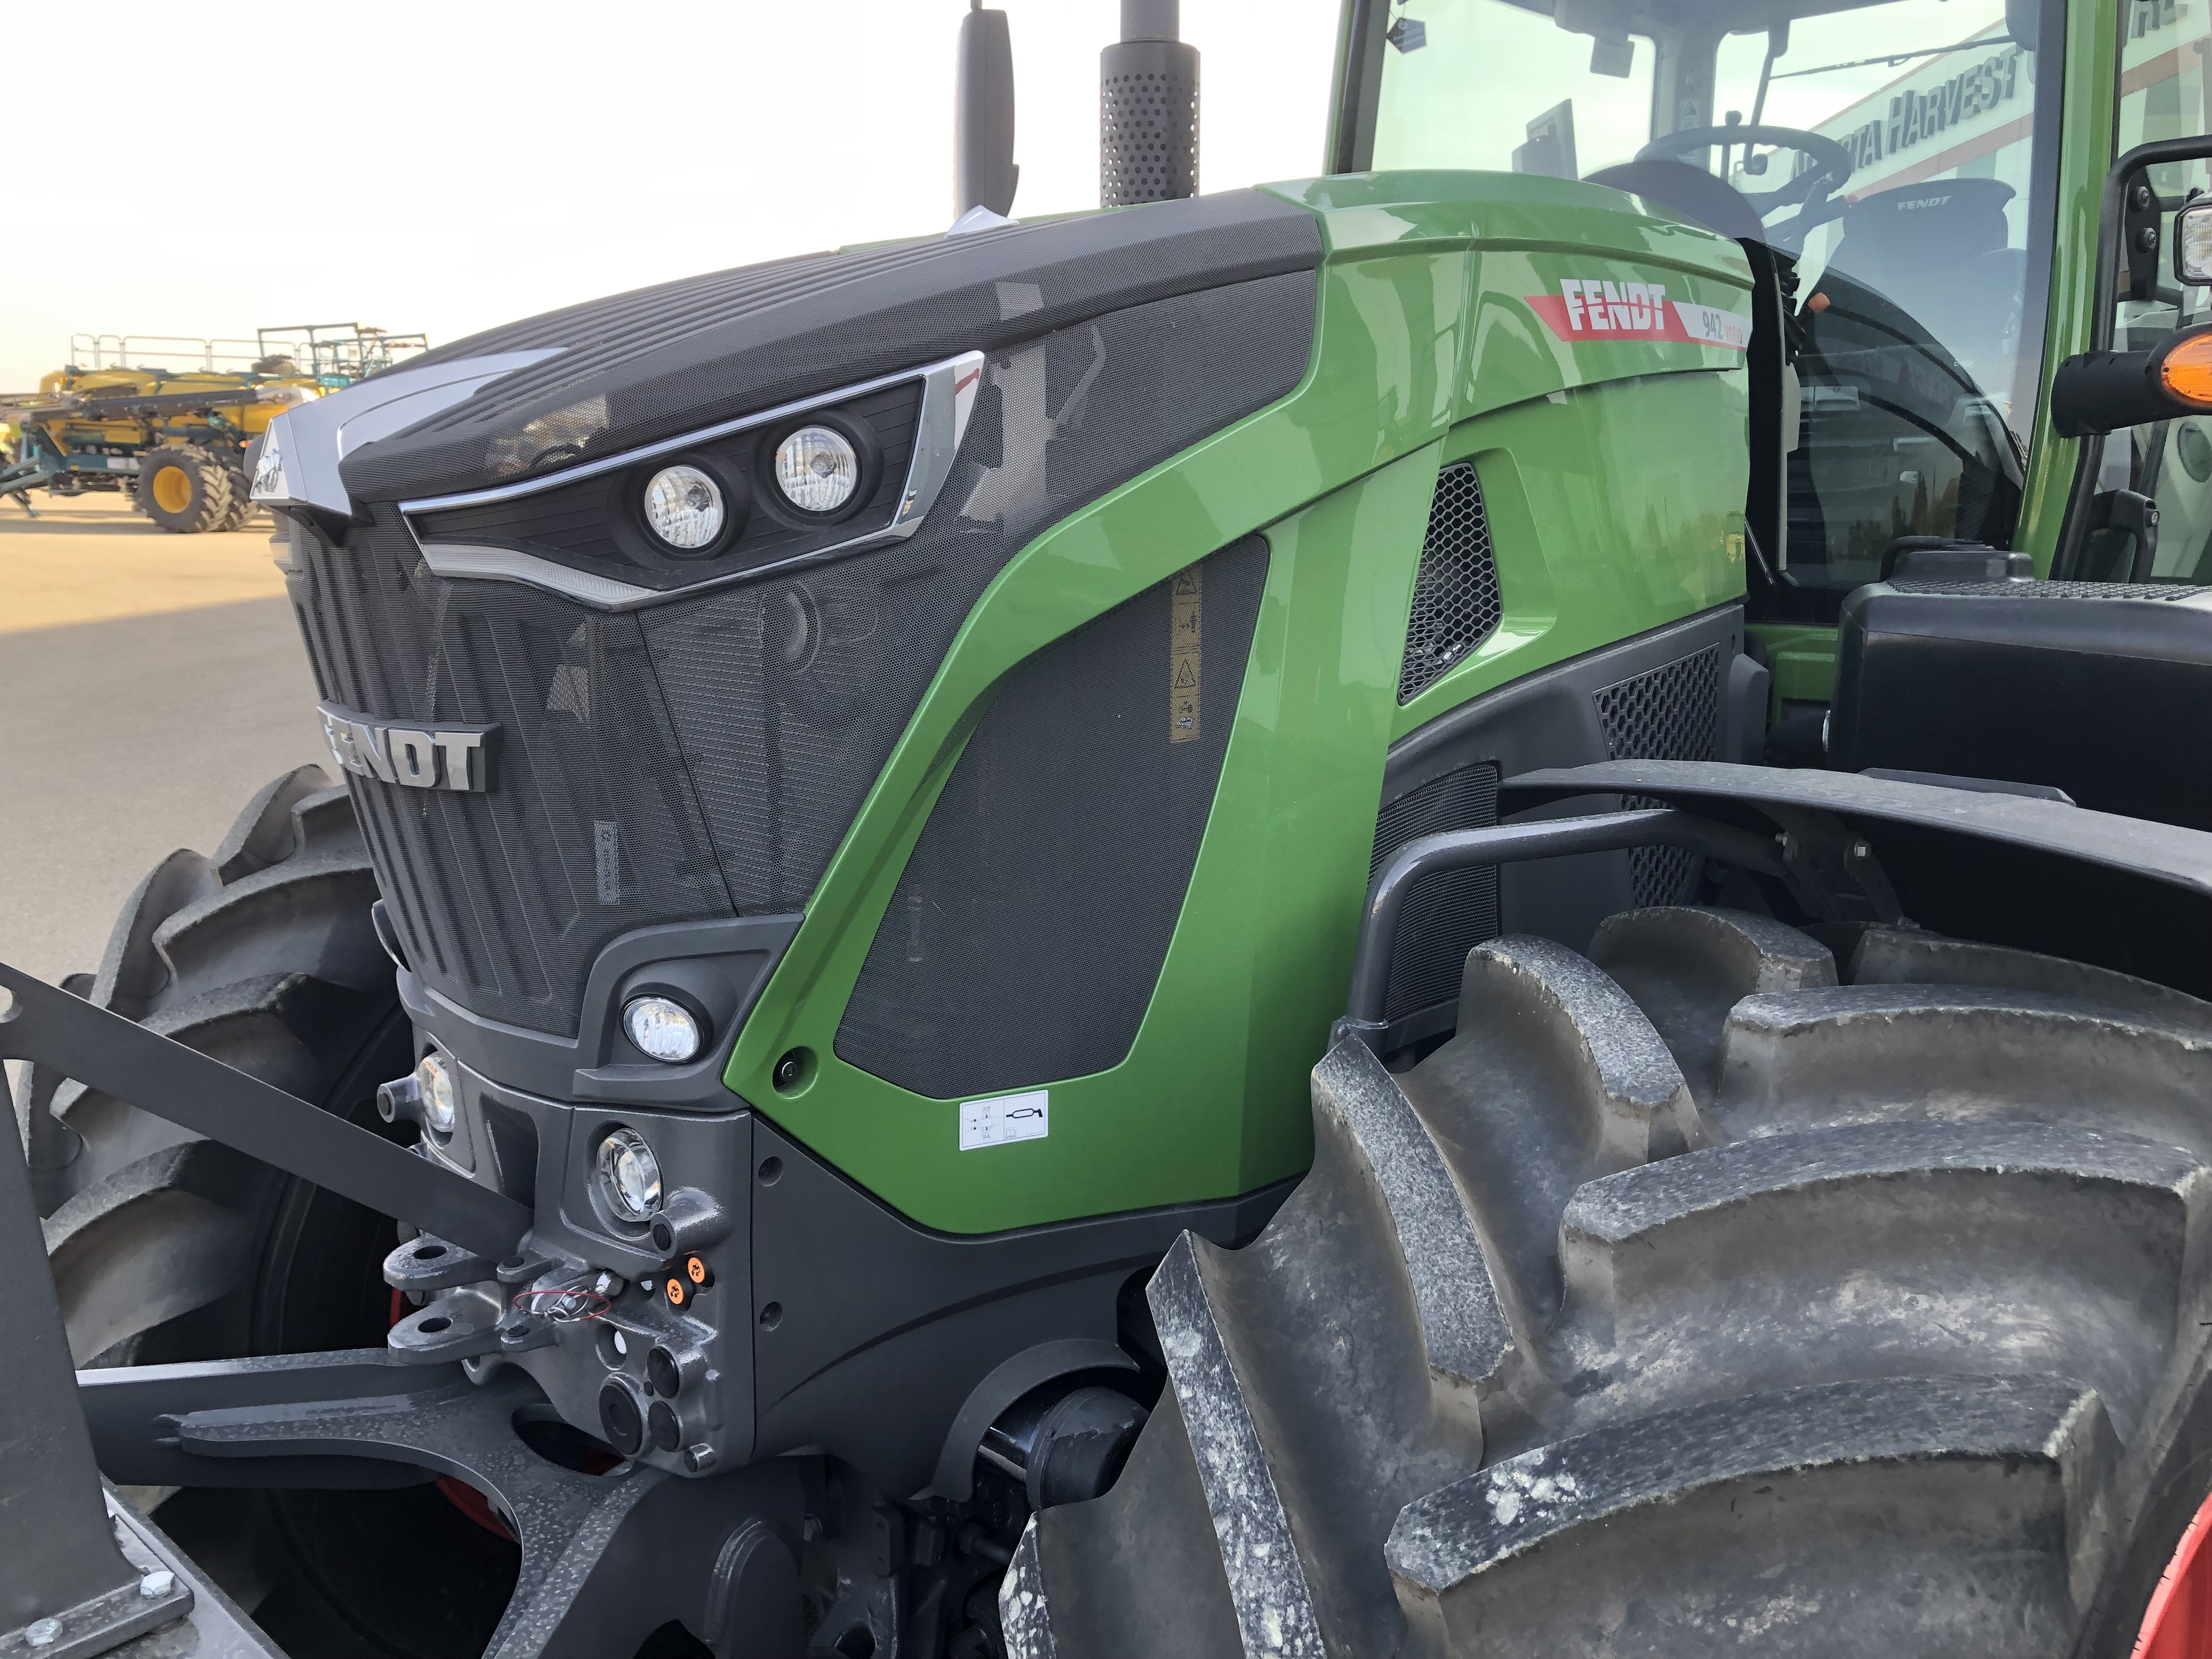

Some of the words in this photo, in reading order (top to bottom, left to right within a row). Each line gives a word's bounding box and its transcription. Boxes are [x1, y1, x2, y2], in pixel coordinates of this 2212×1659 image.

[1886, 43, 2023, 154] HARVEST
[1898, 195, 1952, 211] FENDT
[1560, 279, 1666, 330] FENDT
[1702, 311, 1723, 340] 942
